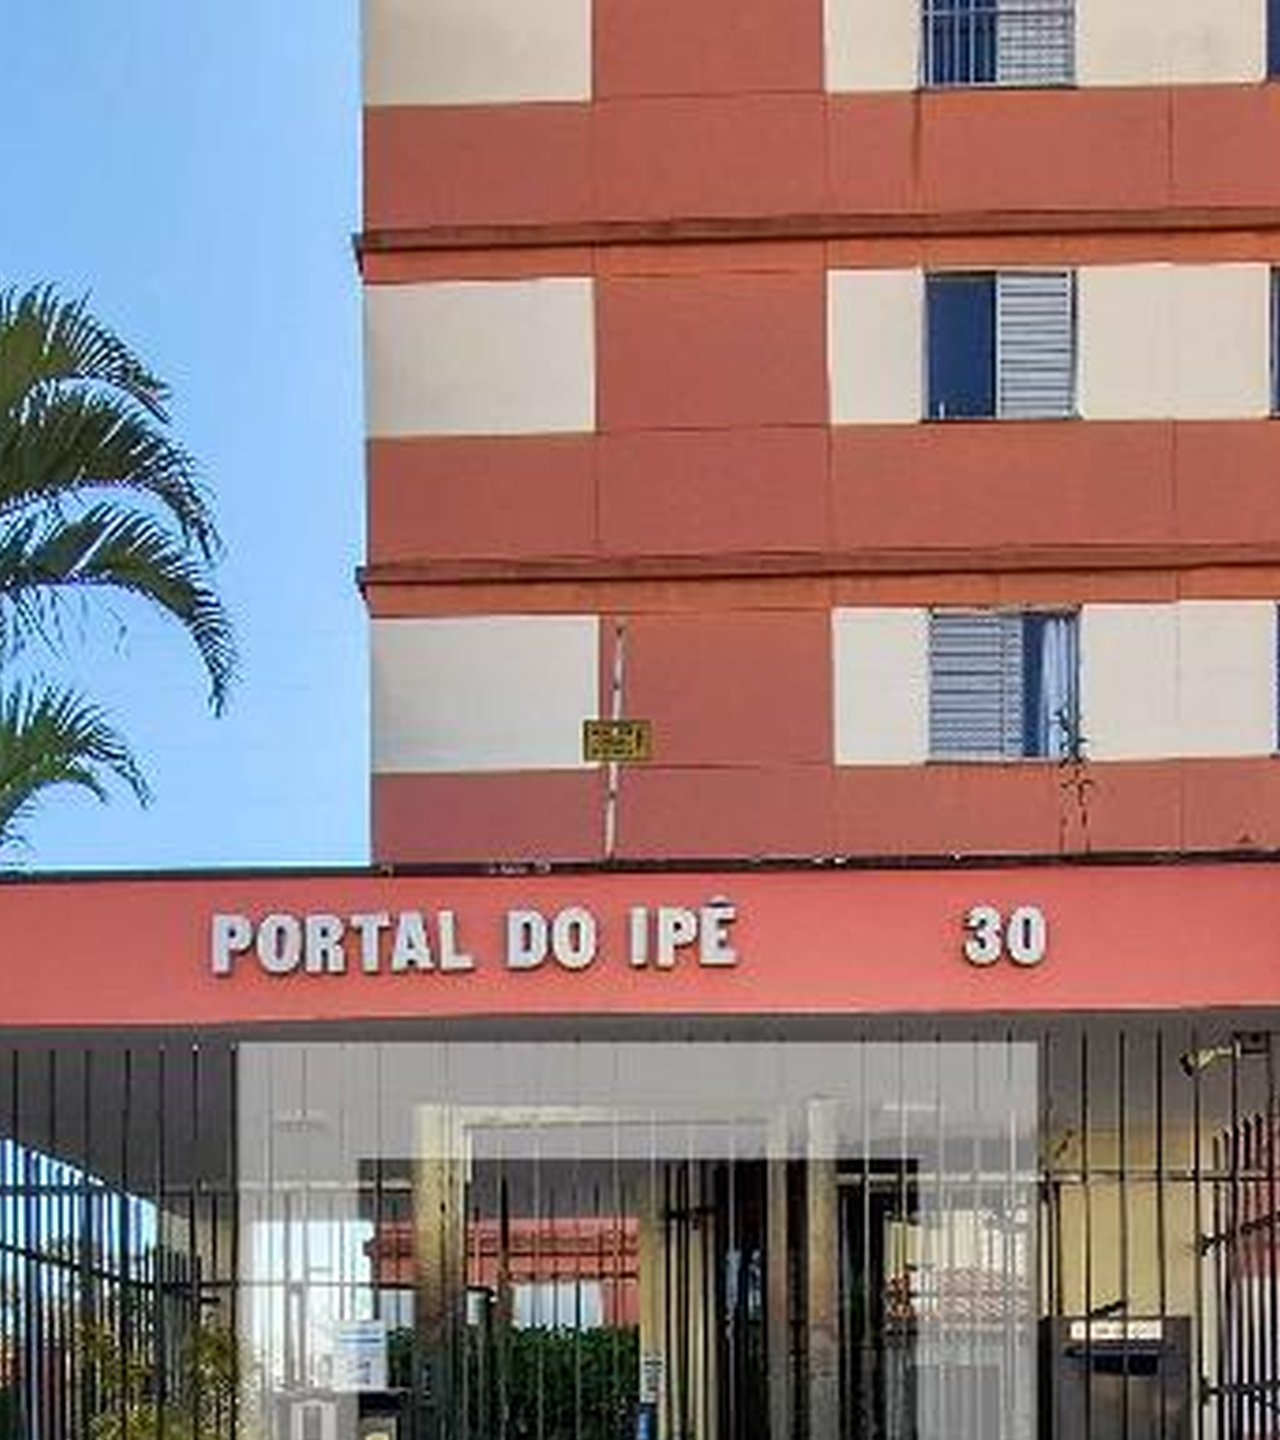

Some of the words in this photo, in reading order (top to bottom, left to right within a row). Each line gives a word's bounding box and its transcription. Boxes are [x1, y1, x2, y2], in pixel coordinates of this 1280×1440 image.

[212, 910, 476, 974] PORTAL
[506, 907, 598, 970] DO
[629, 895, 738, 968] IPÊ
[963, 904, 1047, 967] 30
